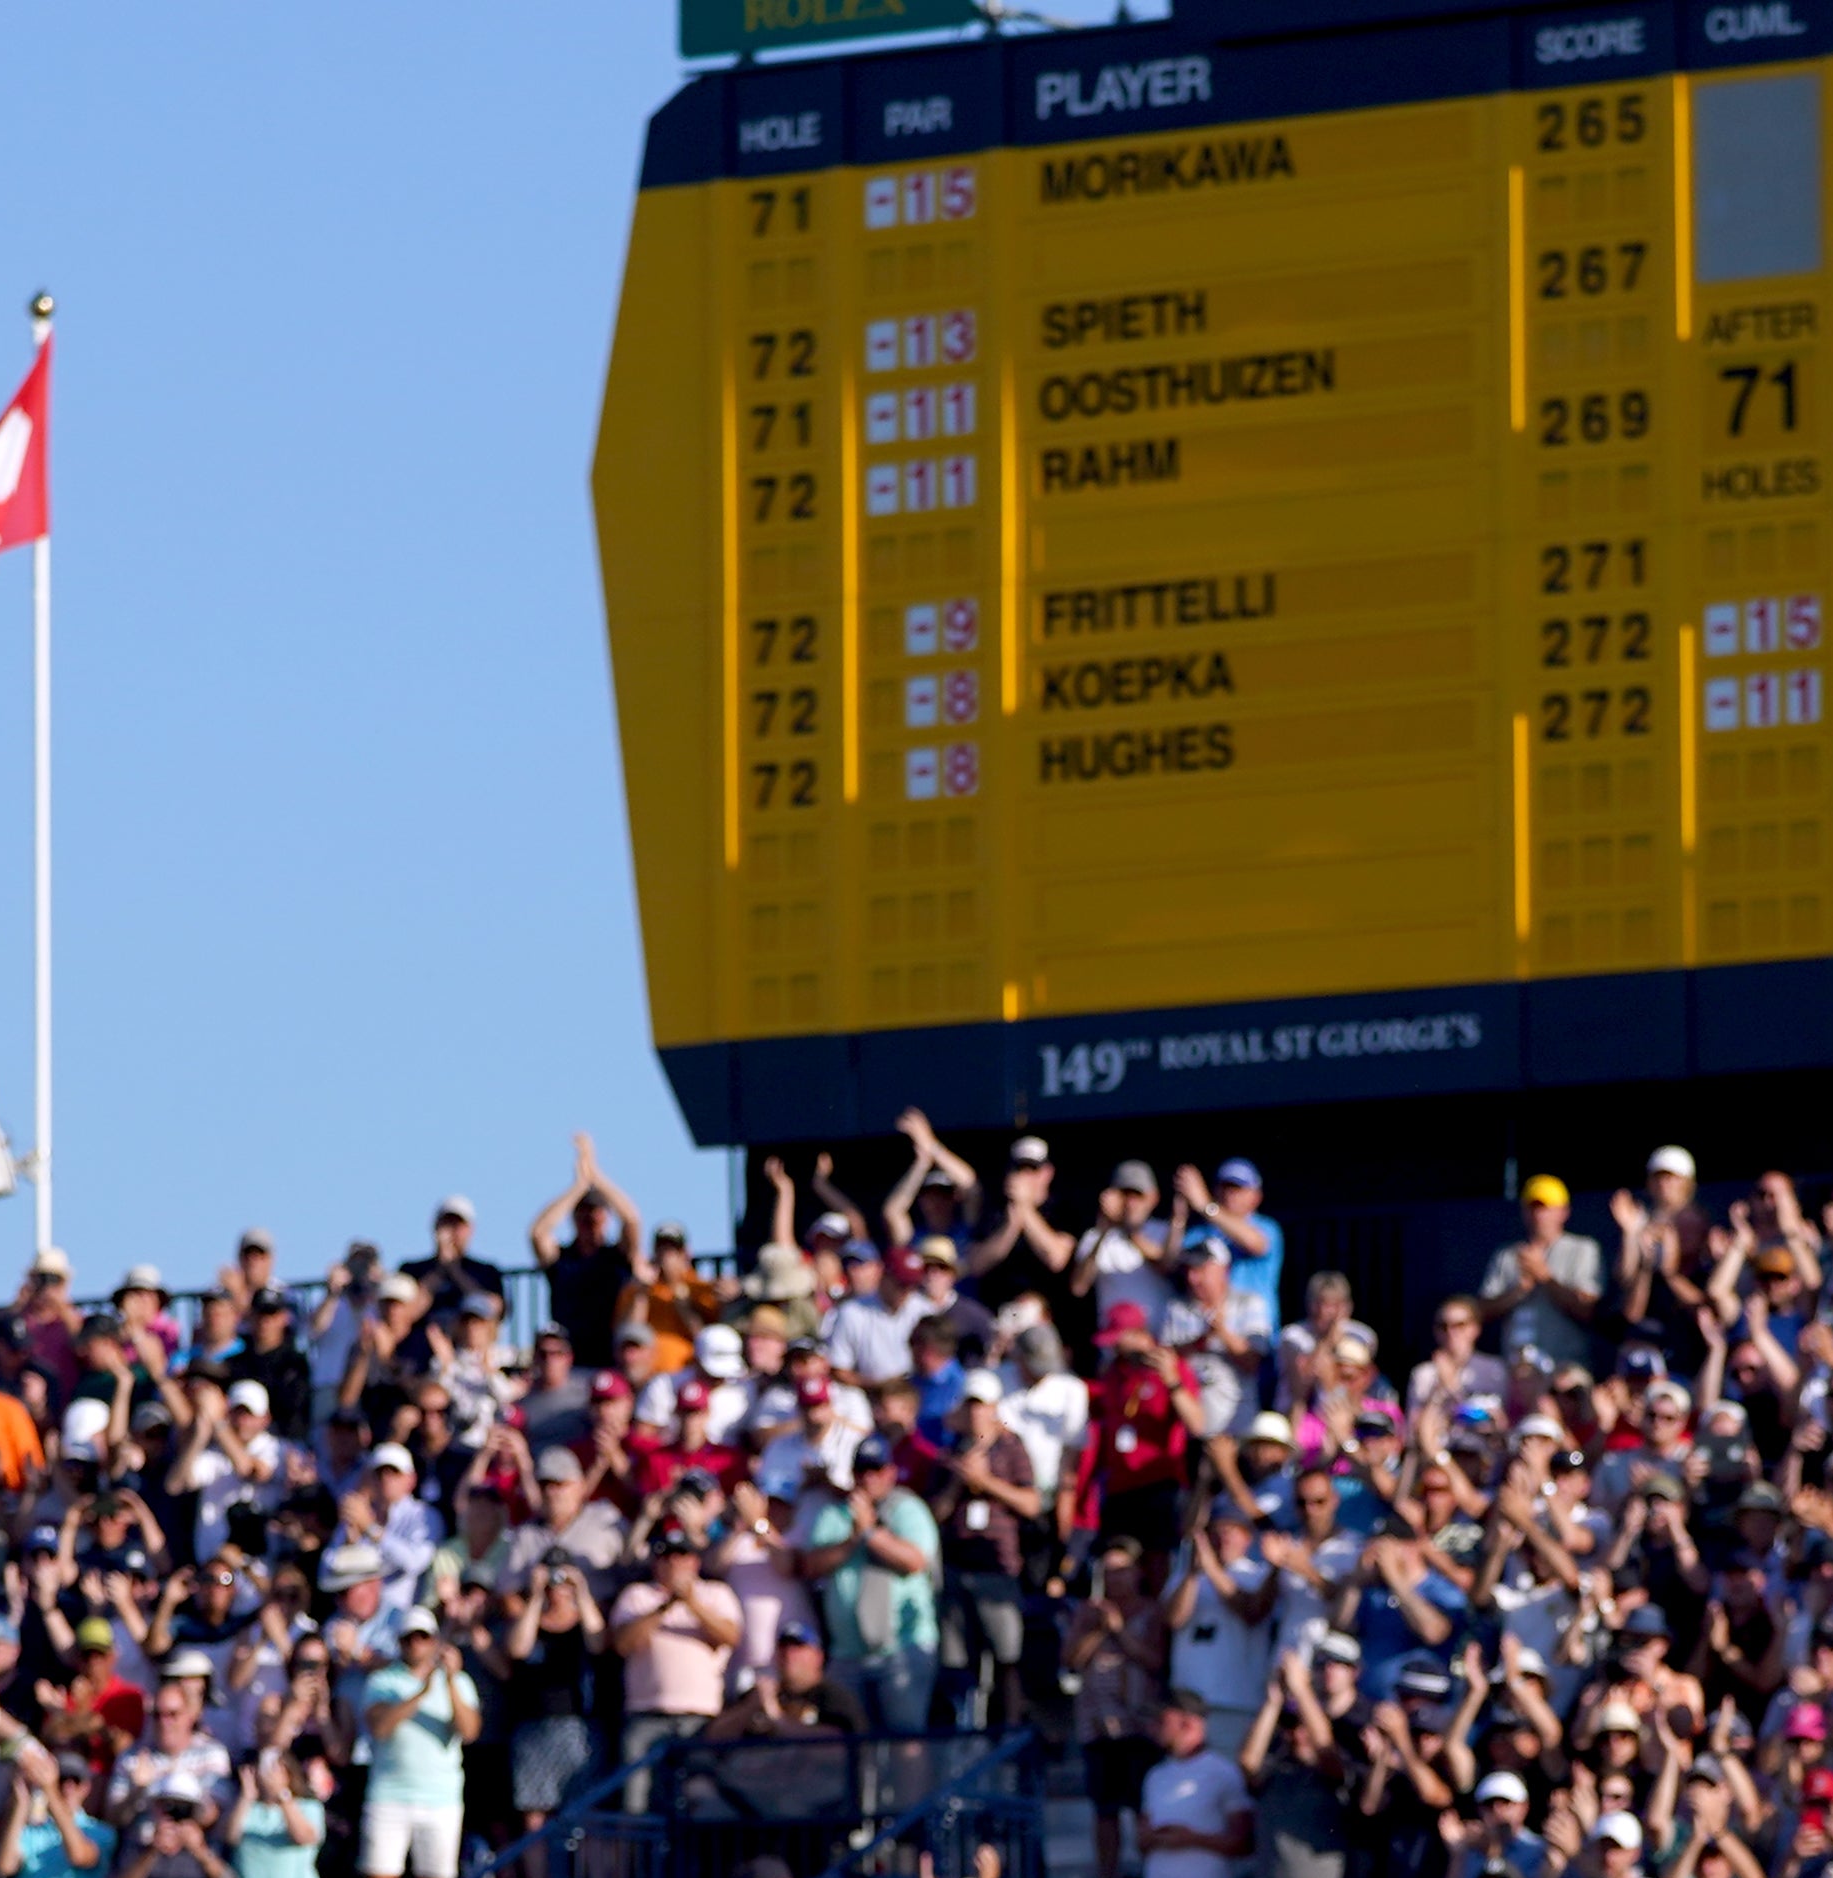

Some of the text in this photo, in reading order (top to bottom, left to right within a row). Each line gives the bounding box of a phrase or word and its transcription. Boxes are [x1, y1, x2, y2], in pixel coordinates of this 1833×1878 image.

[739, 112, 822, 153] HOLE
[884, 98, 952, 138] PAR
[1035, 57, 1212, 120] PLAYER
[1535, 17, 1645, 63] SCORE
[749, 187, 811, 237] 71
[1041, 136, 1295, 202] MORIKAWA
[1537, 95, 1645, 152] 265
[750, 242, 1647, 378] 72 -13 SPIETH 267
[1703, 302, 1816, 345] AFTER
[750, 350, 1335, 452] 71 -11 OOSTHUIZEN
[1721, 361, 1796, 437] 71
[750, 396, 1650, 523] 72 -11 RAHM 269
[1702, 457, 1821, 501] HOLES
[752, 617, 817, 666] 72
[1041, 574, 1276, 639] FRITTELLI
[1542, 541, 1647, 593] 271
[1706, 597, 1820, 655] -15
[752, 690, 817, 738] 72
[1041, 652, 1234, 711] KOEPKA
[1542, 614, 1651, 668] 272
[1706, 671, 1820, 731] -11
[752, 762, 817, 810] 72
[1041, 725, 1234, 784] HUGHES
[1542, 686, 1651, 741] 272
[1159, 1030, 1268, 1069] ROYAL
[1269, 1025, 1314, 1060] ST
